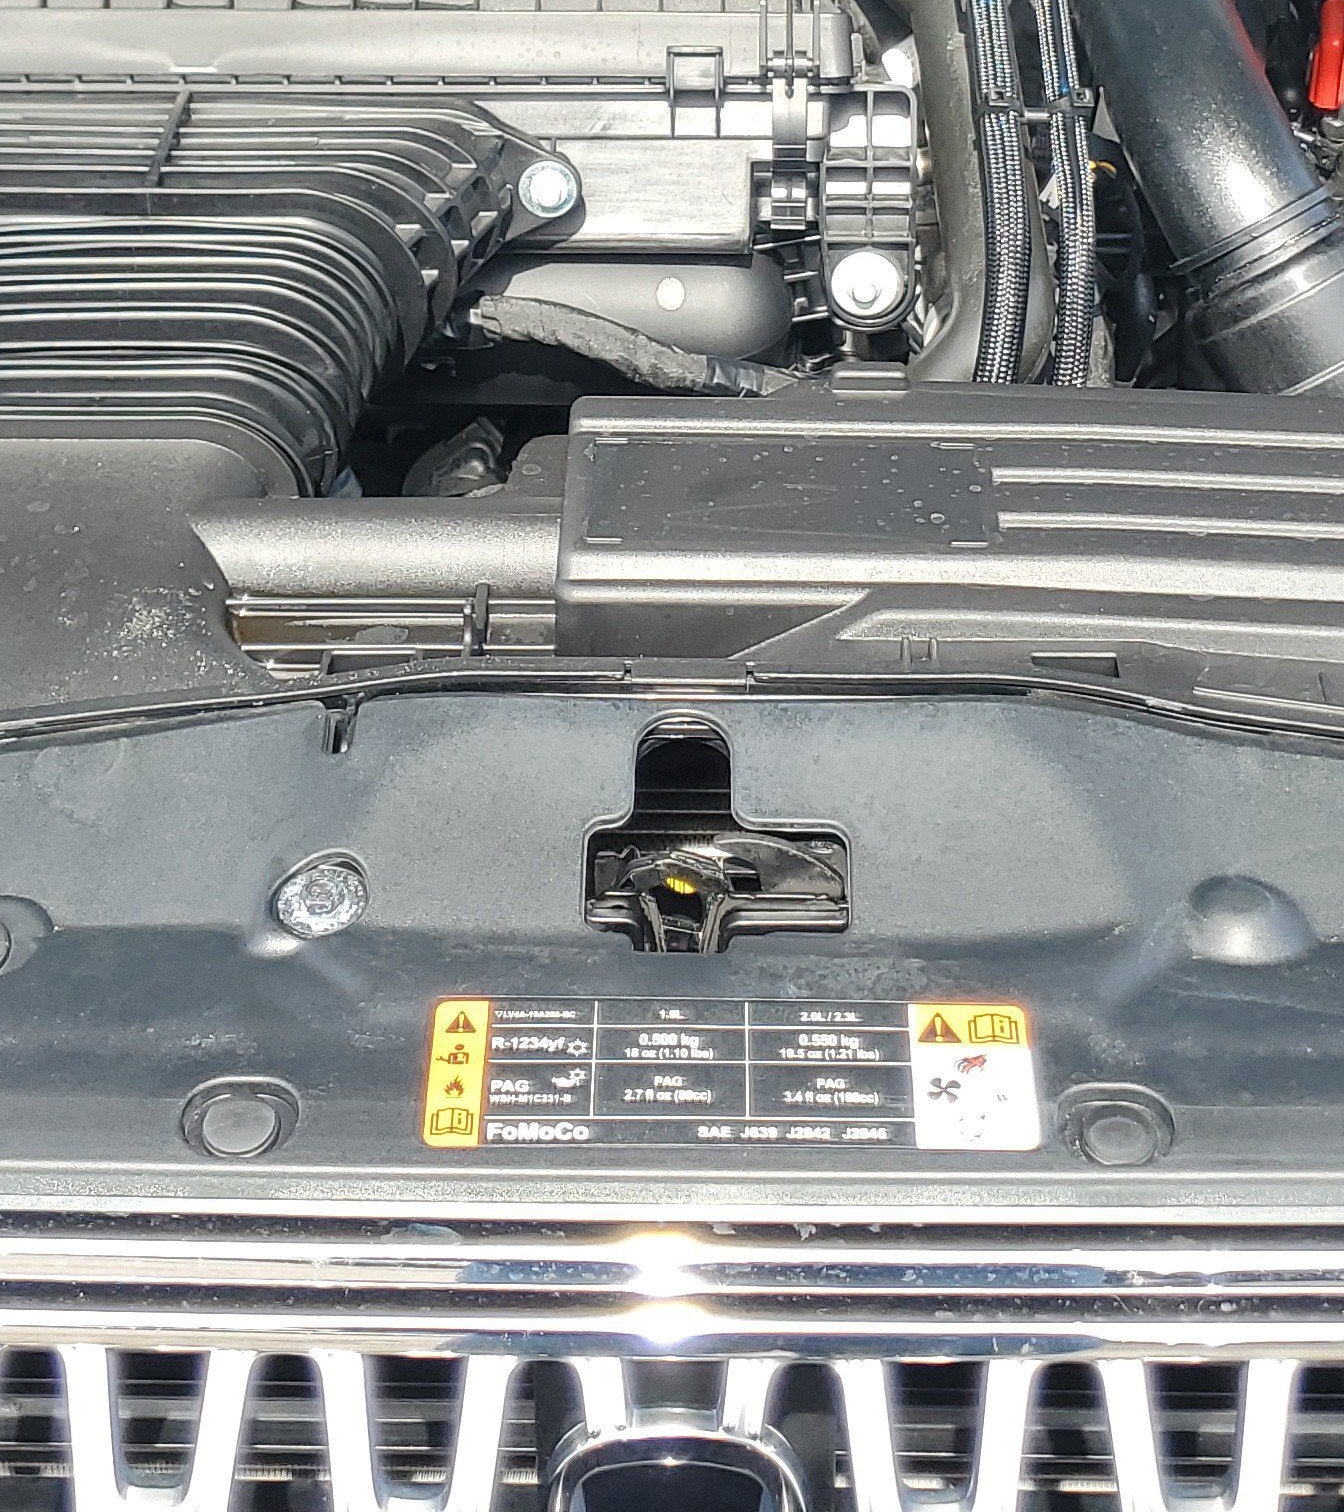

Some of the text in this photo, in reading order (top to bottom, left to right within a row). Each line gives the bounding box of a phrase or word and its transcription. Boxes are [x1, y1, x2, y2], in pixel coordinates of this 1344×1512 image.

[491, 1036, 566, 1052] R-1234yf
[680, 1032, 700, 1048] kg
[840, 1033, 860, 1049] kg
[490, 1079, 530, 1093] PAG
[653, 1075, 683, 1087] PAG
[816, 1078, 845, 1089] PAG
[486, 1121, 590, 1141] FoMoCo
[697, 1125, 733, 1138] SAE
